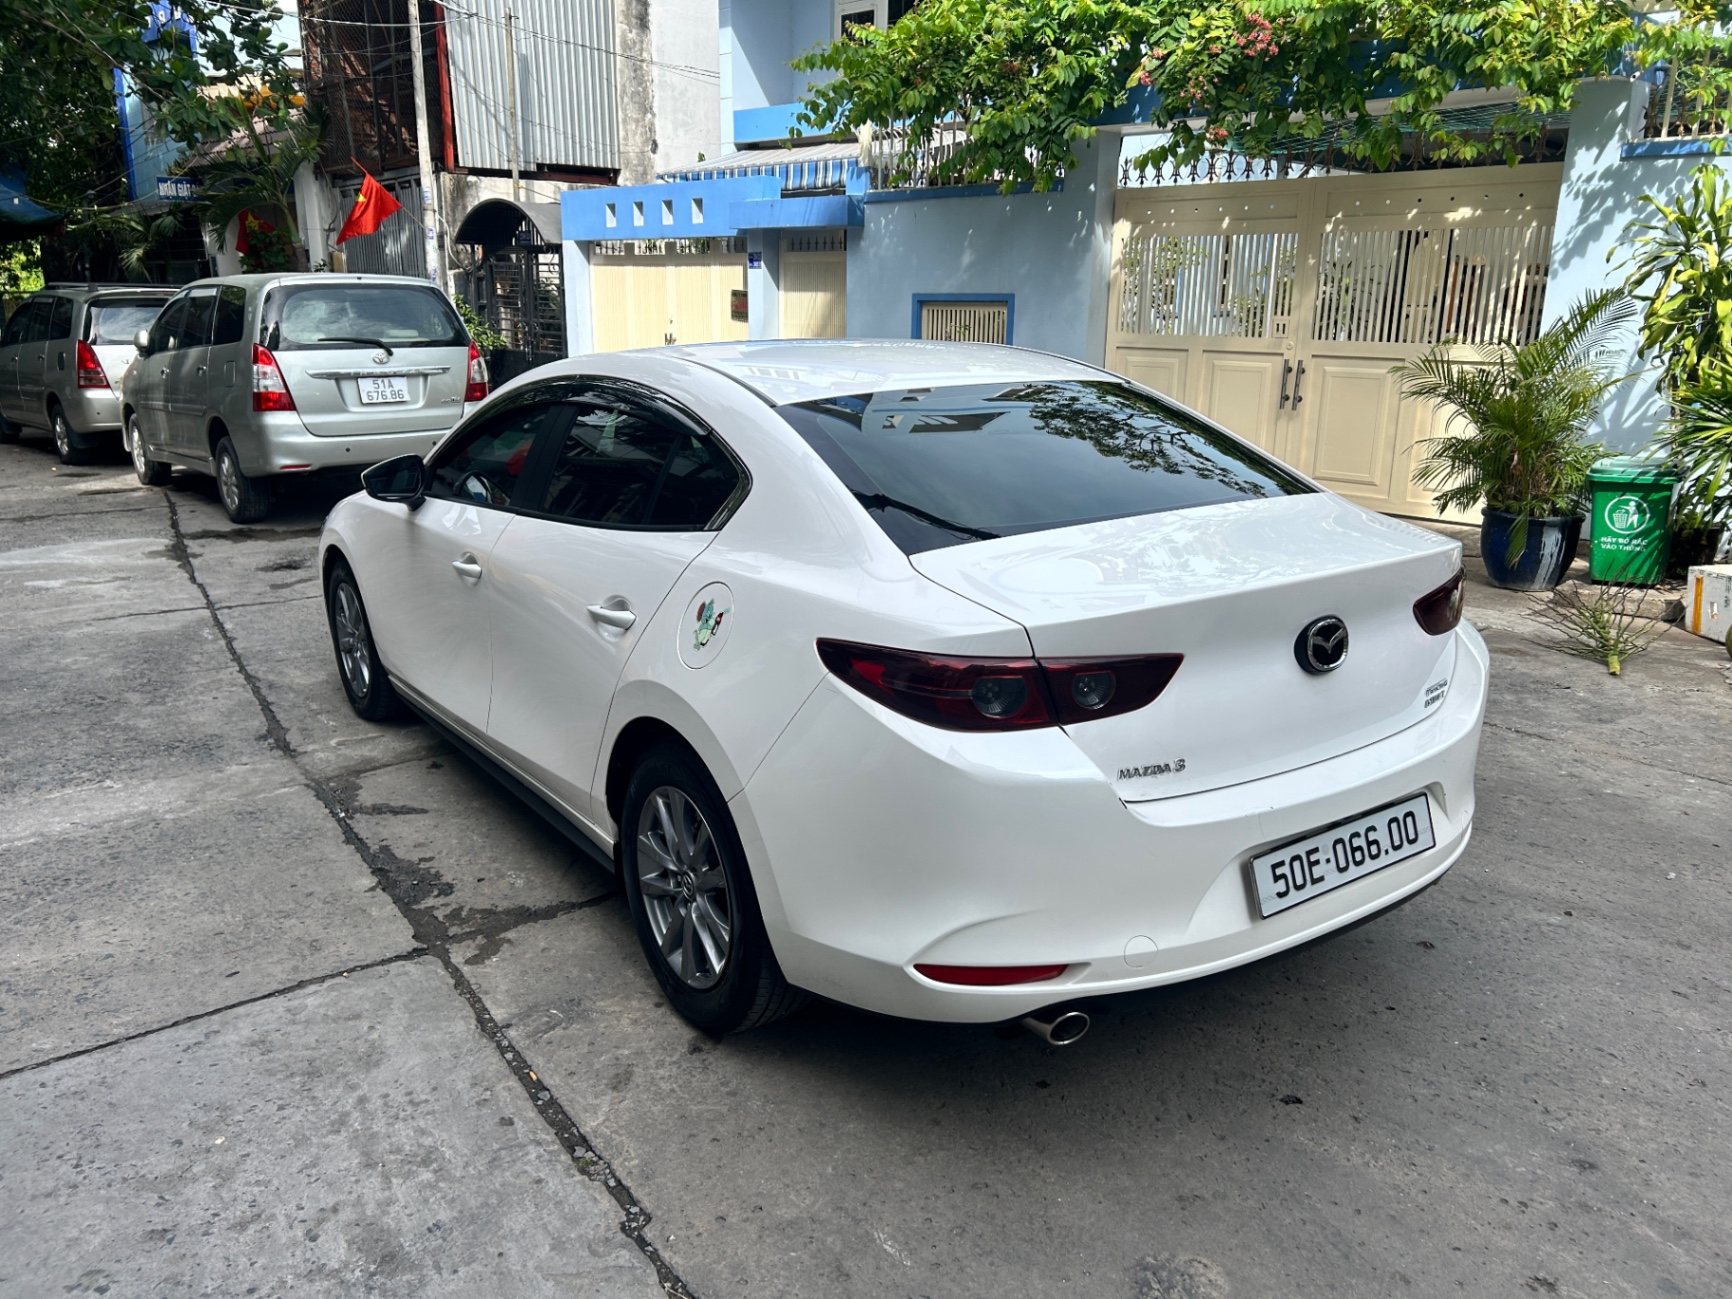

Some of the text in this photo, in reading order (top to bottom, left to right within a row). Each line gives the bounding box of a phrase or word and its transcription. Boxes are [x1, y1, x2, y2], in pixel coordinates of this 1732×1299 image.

[372, 379, 394, 390] 51A
[366, 389, 405, 402] 676.86
[1270, 810, 1419, 899] 50E-066.00
